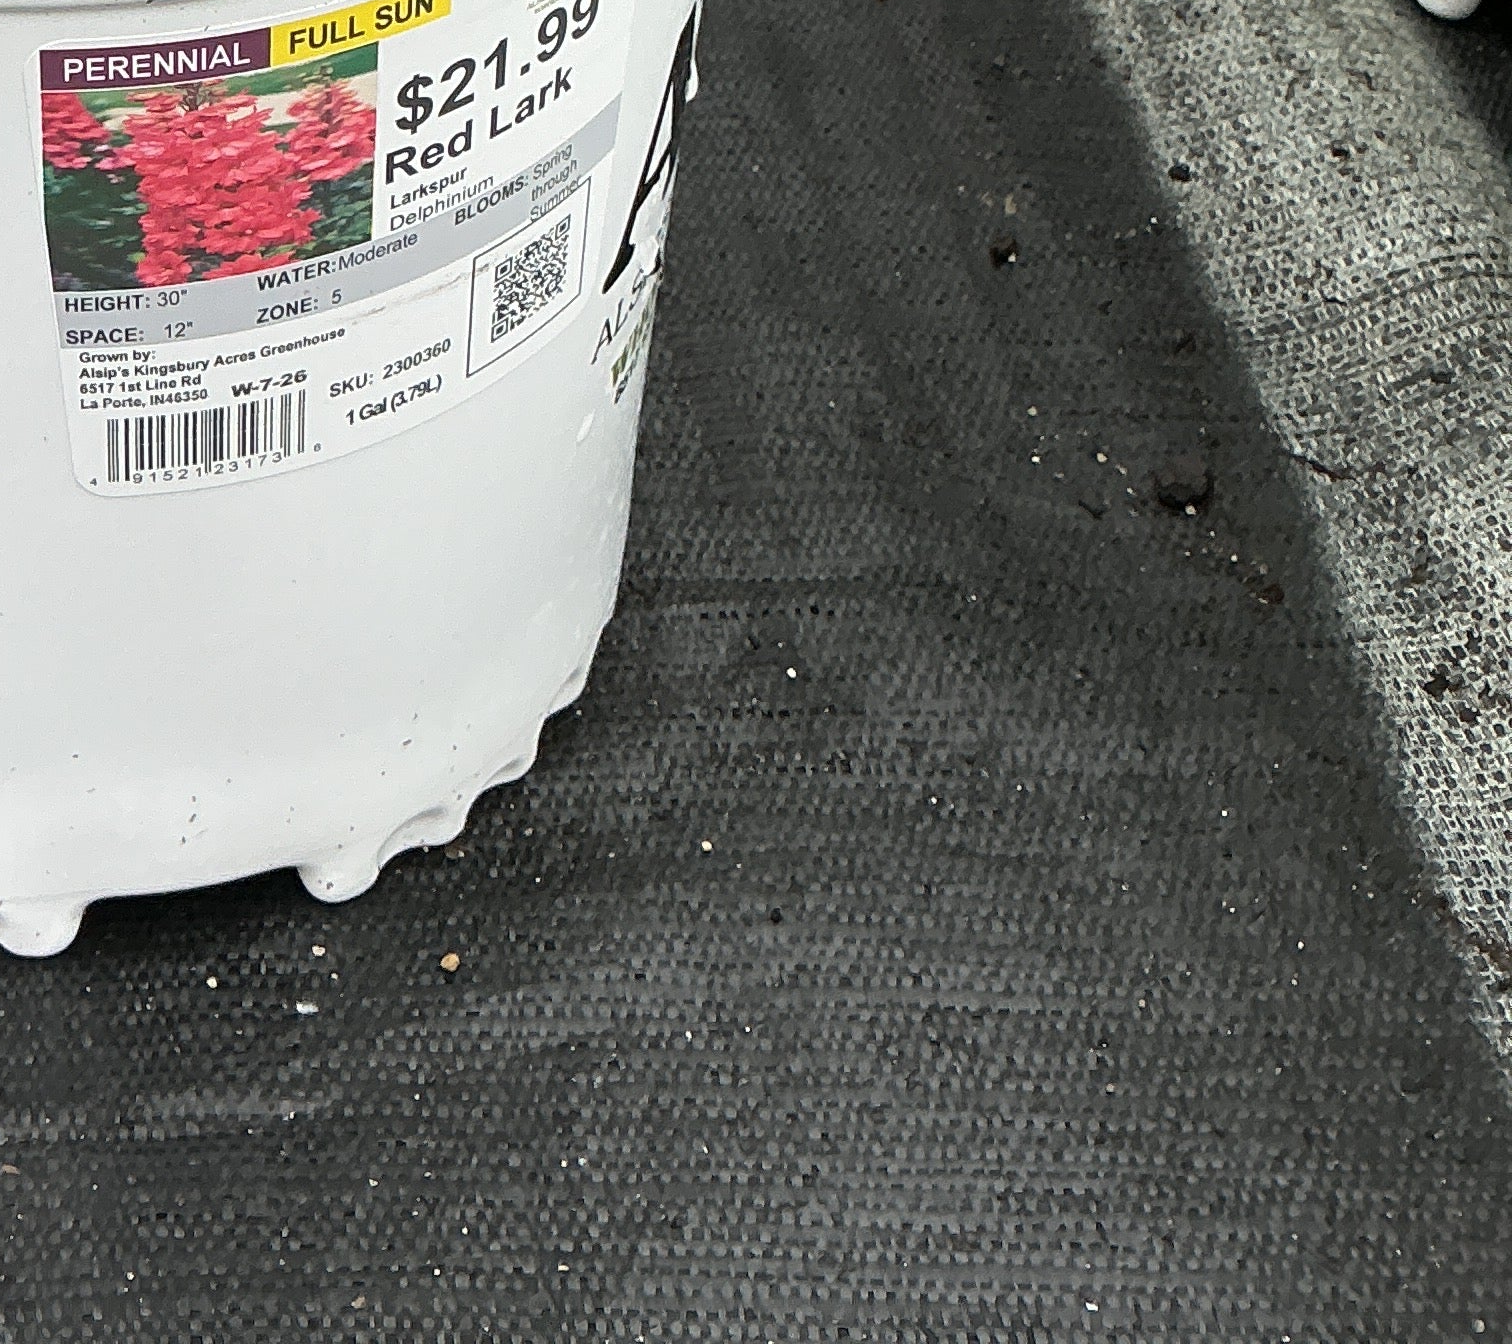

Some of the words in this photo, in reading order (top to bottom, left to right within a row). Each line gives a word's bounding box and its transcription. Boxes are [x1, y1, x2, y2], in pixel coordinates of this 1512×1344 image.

[289, 15, 365, 55] FULL
[63, 42, 251, 82] PERENNIAL
[385, 118, 474, 185] Red
[489, 66, 573, 140] Lark
[390, 166, 468, 210] Larkspur
[454, 174, 529, 226] BLOOMS:
[532, 143, 573, 180] Spring
[529, 175, 583, 223] Summer
[530, 159, 578, 202] through
[390, 175, 494, 231] Delphinium
[257, 257, 337, 292] WATER:
[337, 230, 419, 271] Moderate
[64, 293, 151, 313] HEIGHT:
[156, 289, 188, 308] 30"
[256, 296, 319, 325] ZONE:
[331, 288, 342, 306] 5
[65, 327, 145, 346] SPACE:
[164, 320, 194, 339] 12"
[79, 364, 130, 380] Alsip's
[134, 359, 210, 377] Kingsbury
[213, 351, 256, 368] Acres
[260, 327, 346, 358] Greenhouse
[79, 352, 128, 364] Grown
[133, 349, 157, 363] by:
[329, 373, 374, 398] SKU:
[382, 338, 452, 380] 2300360
[79, 383, 113, 395] 6517
[119, 380, 141, 393] 1st
[145, 378, 177, 391] Line
[181, 374, 201, 387] Rd
[80, 397, 99, 410] La
[231, 370, 309, 398] W-7-26
[345, 408, 355, 425] 1
[359, 396, 387, 421] Gal
[390, 374, 443, 413] (3.79L)
[132, 467, 202, 484] 91521
[213, 451, 283, 474] 23173
